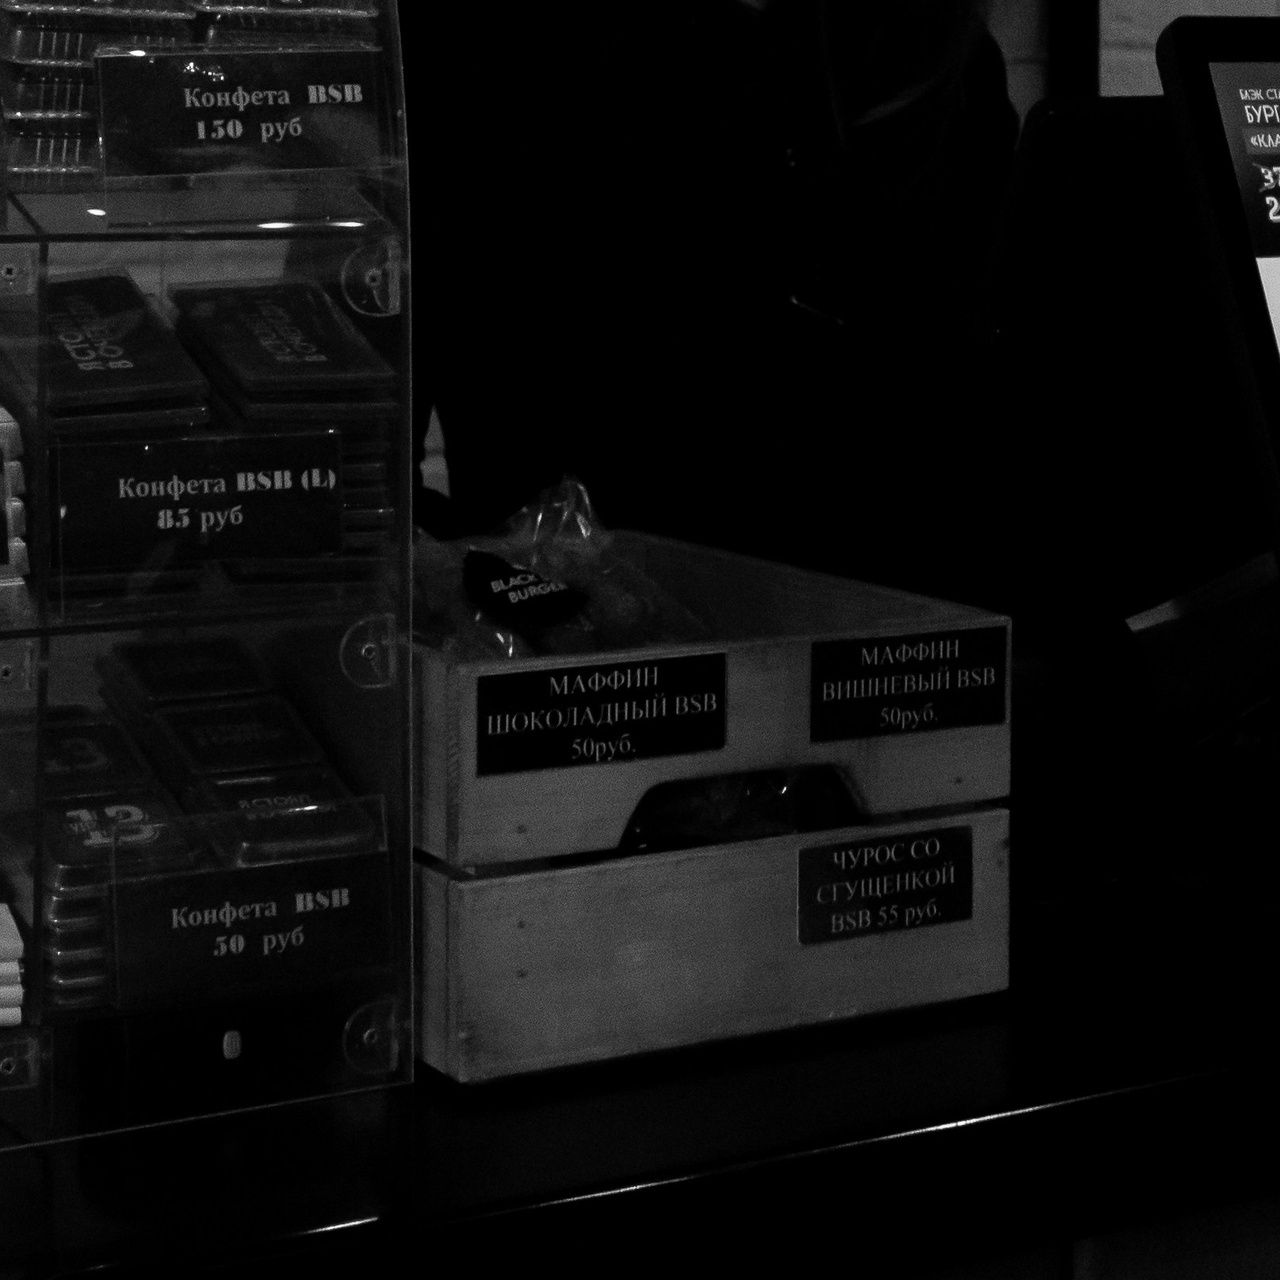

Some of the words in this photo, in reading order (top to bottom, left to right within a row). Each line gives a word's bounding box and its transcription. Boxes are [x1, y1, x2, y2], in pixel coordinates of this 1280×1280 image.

[184, 87, 291, 111] Конфета
[307, 83, 364, 104] BSB
[197, 119, 244, 140] 150
[260, 117, 302, 143] руб
[118, 475, 226, 501] Конфета
[236, 469, 293, 492] BSB
[301, 468, 337, 490] (L)
[156, 508, 191, 530] 85
[200, 505, 244, 533] руб
[861, 639, 960, 667] МАФФИН
[549, 666, 659, 697] МАФФИН
[822, 666, 950, 703] ВИШНЕВЫЙ
[957, 666, 996, 689] BSB
[487, 692, 667, 736] ШОКОЛАДНЫЙ
[674, 692, 718, 716] BSB
[879, 703, 939, 730] 50руб.
[571, 732, 637, 762] 50руб.
[833, 843, 905, 871] ЧУРОС
[910, 837, 940, 859] СО
[816, 861, 955, 904] СГУЩЕНКОЙ
[171, 900, 278, 929] Конфета
[294, 887, 351, 914] BSB
[830, 909, 871, 934] BSB
[878, 905, 899, 927] 55
[904, 898, 942, 927] руб.
[213, 935, 245, 957] 50
[263, 927, 305, 955] руб
